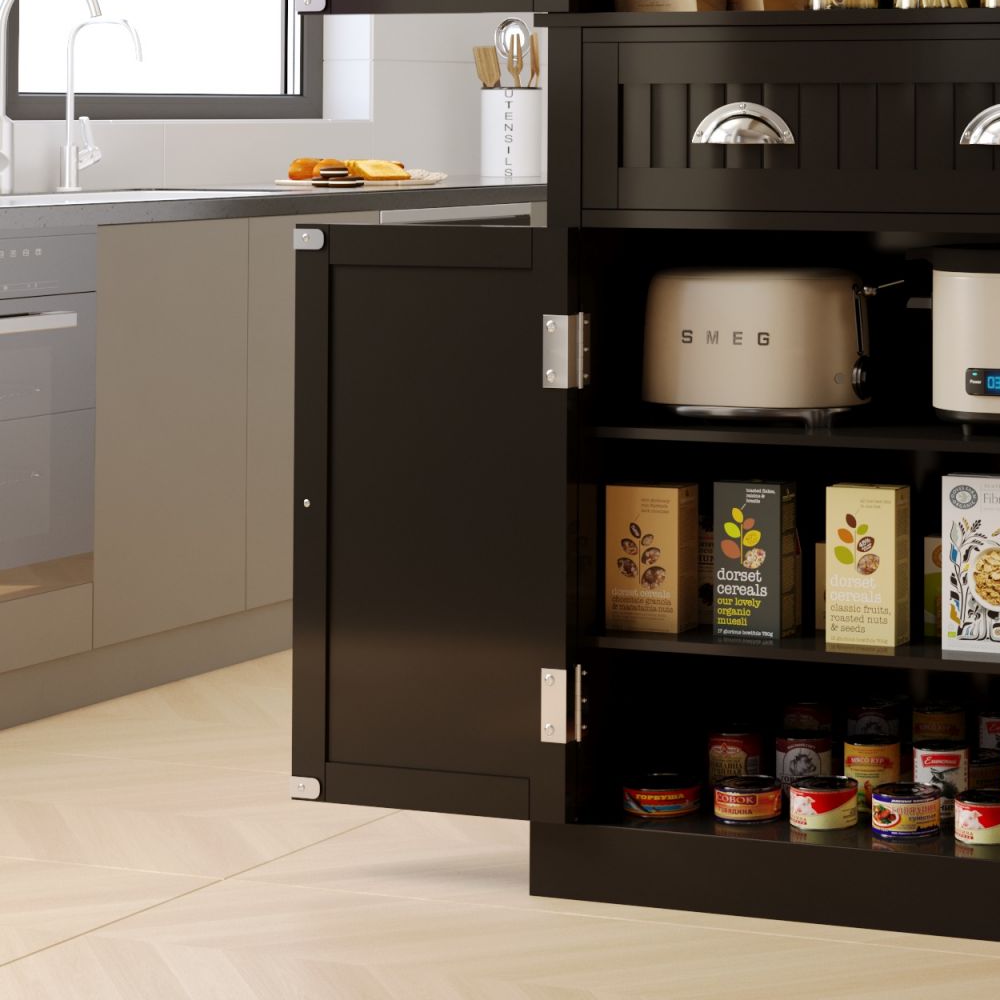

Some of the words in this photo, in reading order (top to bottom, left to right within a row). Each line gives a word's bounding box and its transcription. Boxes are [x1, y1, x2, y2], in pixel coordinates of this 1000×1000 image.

[504, 89, 514, 177] UTENSILS
[681, 329, 770, 346] SMEG
[717, 568, 762, 582] dorset
[717, 584, 768, 597] cereals
[717, 598, 733, 606] our
[735, 597, 761, 608] lovely
[830, 603, 861, 613] classic
[717, 607, 751, 616] organic
[717, 617, 748, 626] muesli
[830, 614, 864, 623] roasted
[867, 616, 888, 624] nuts
[830, 622, 839, 632] &
[840, 624, 866, 633] seeds
[718, 794, 755, 804] СОВОК
